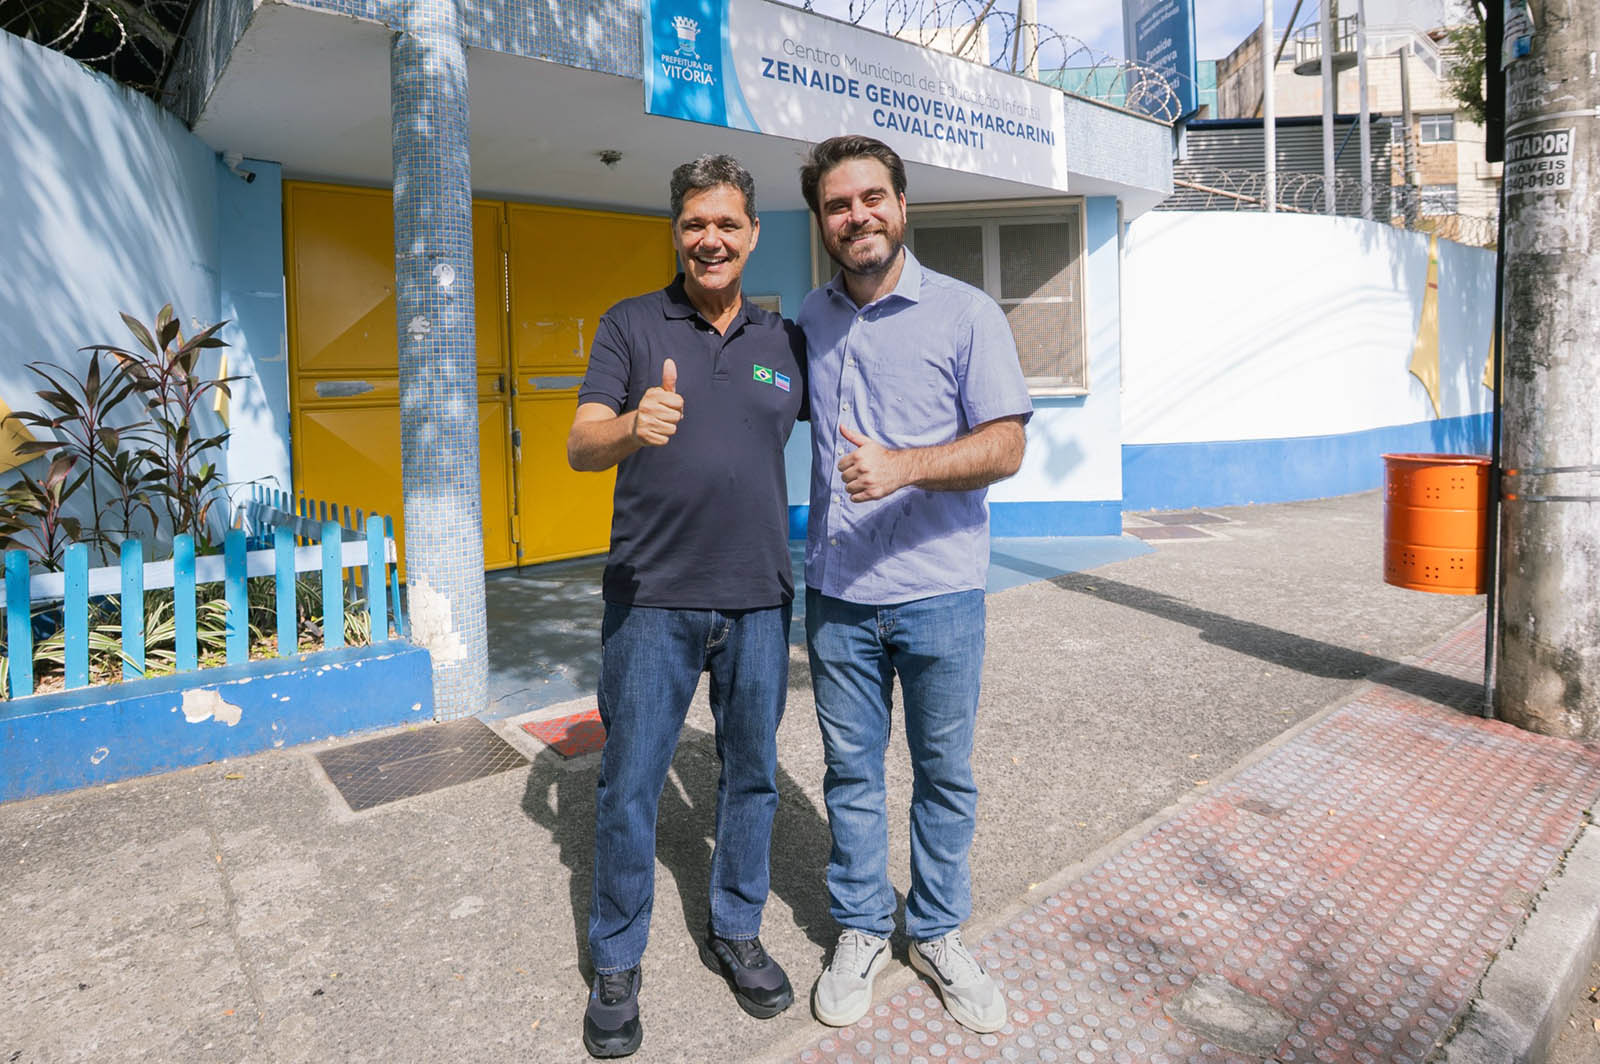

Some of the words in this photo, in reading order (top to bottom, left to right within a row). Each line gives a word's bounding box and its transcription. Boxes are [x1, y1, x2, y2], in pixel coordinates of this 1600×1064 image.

[661, 54, 702, 69] PREFEITURA
[704, 63, 713, 72] DE
[662, 63, 714, 86] VITÓRIA
[782, 38, 840, 67] Centro
[844, 54, 917, 88] Municipal
[919, 75, 936, 94] de
[1002, 98, 1040, 120] Infantil
[762, 57, 860, 98] ZENAIDE
[866, 84, 966, 124] GENOVEVA
[970, 110, 1055, 146] MARCARINI
[873, 109, 984, 150] CAVALCANTI
